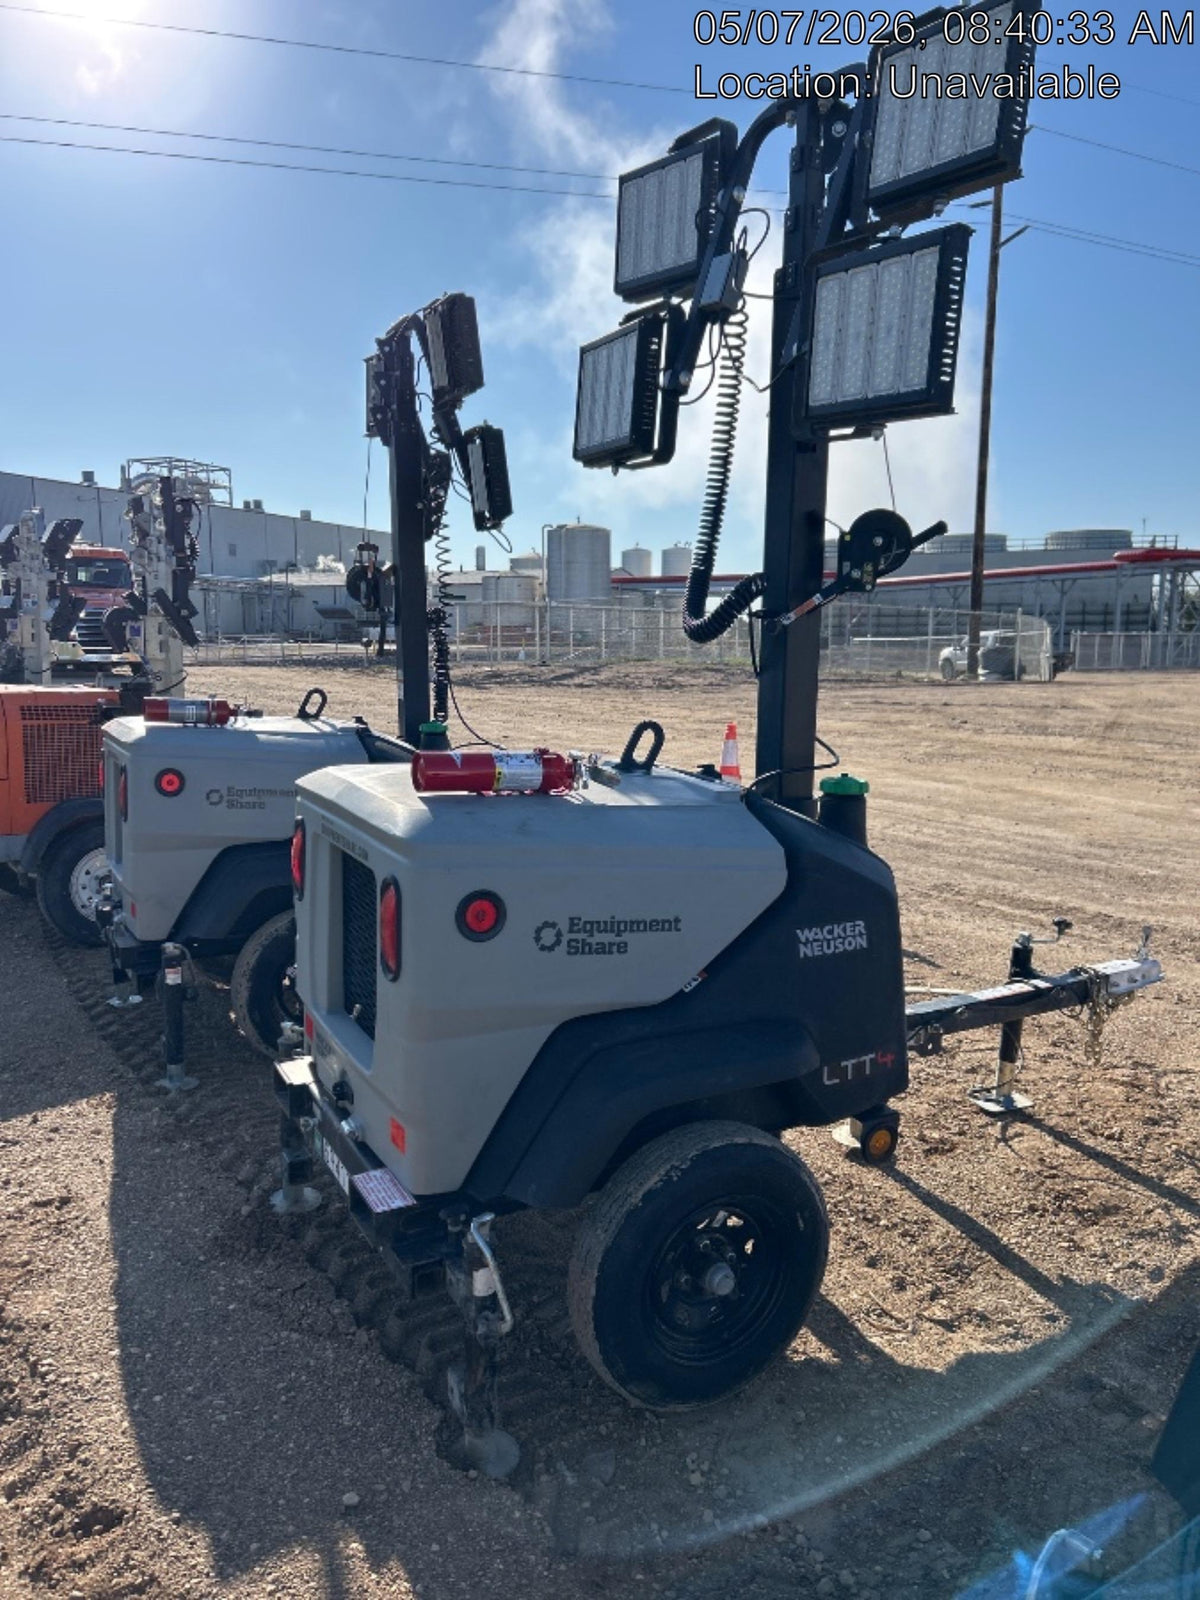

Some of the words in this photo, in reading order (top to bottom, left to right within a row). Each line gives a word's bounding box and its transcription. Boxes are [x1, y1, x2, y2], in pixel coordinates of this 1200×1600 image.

[567, 915, 682, 937] Equipment
[796, 920, 867, 943] WACKER
[566, 938, 628, 955] Share
[799, 935, 869, 958] NEUSON
